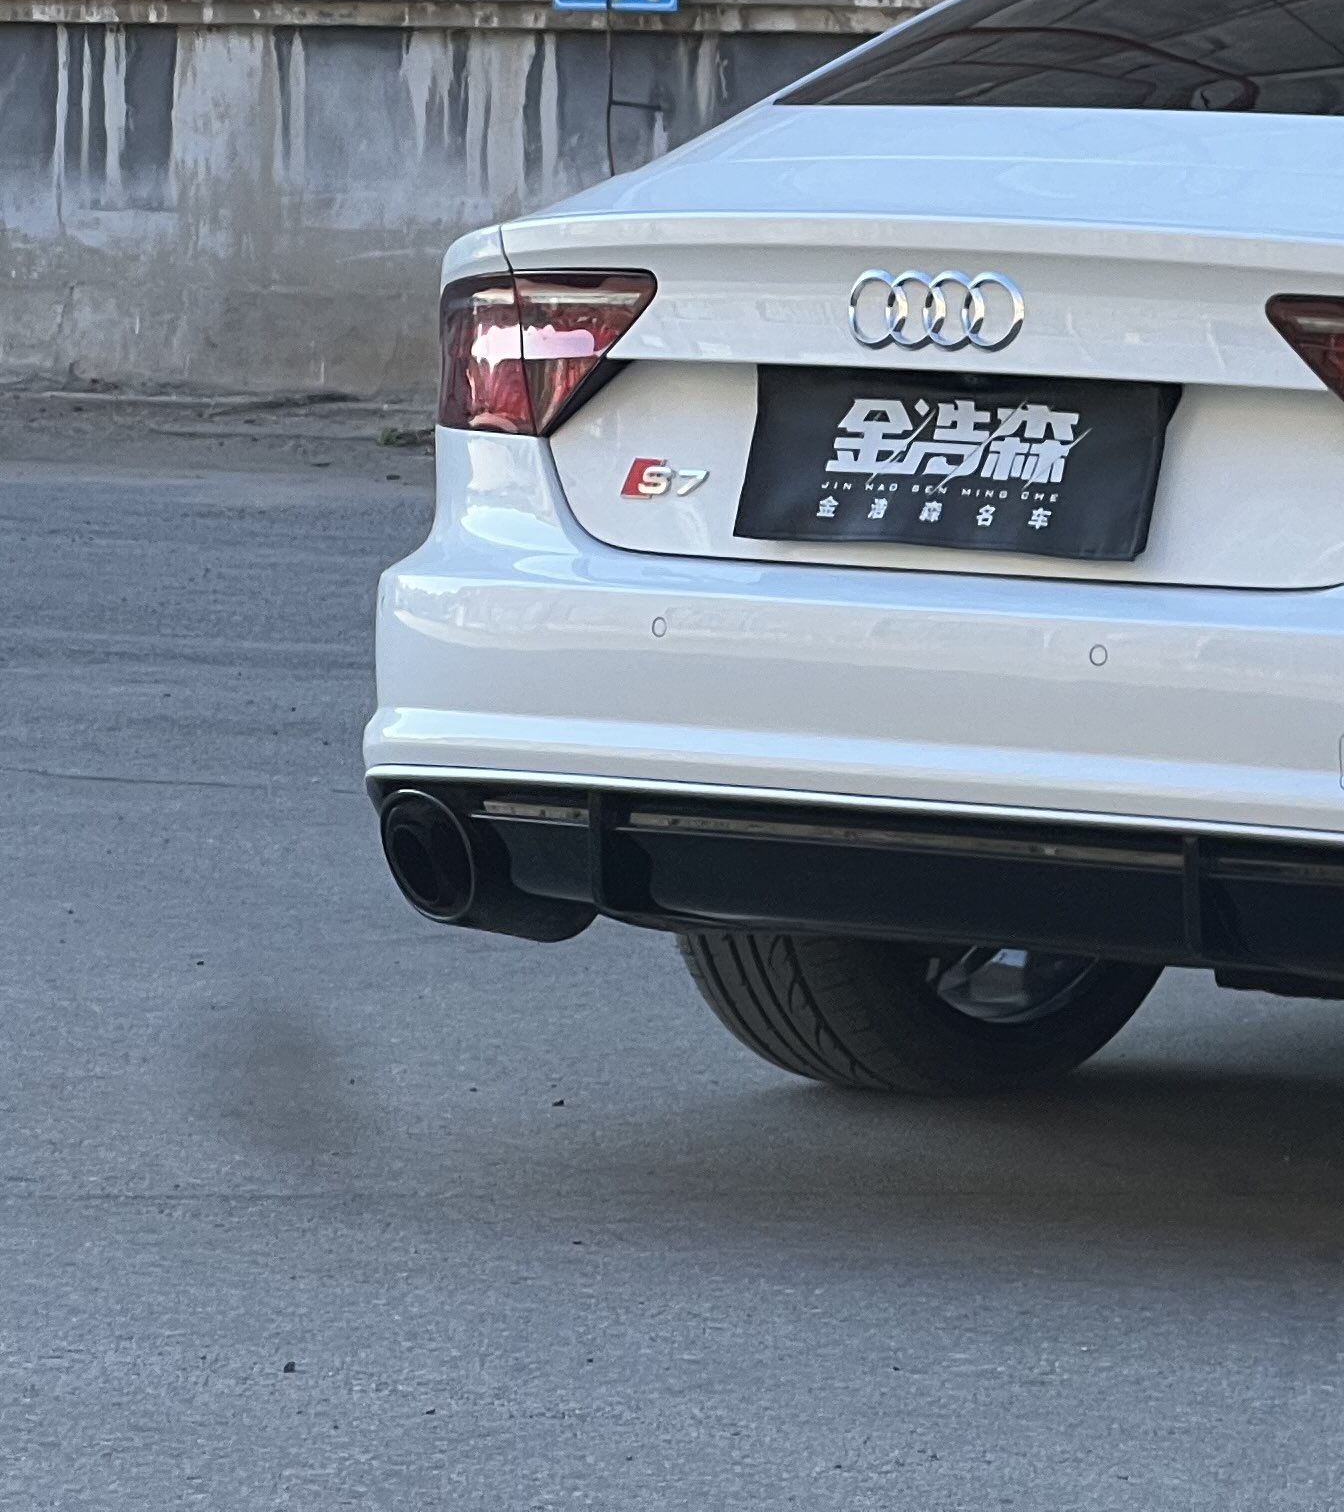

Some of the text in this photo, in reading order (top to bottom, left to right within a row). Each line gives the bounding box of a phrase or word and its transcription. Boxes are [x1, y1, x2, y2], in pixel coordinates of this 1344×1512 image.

[637, 465, 711, 497] S7
[821, 481, 853, 491] JIN
[865, 482, 899, 493] HAO
[961, 488, 1009, 500] MING
[1020, 491, 1060, 503] CHE
